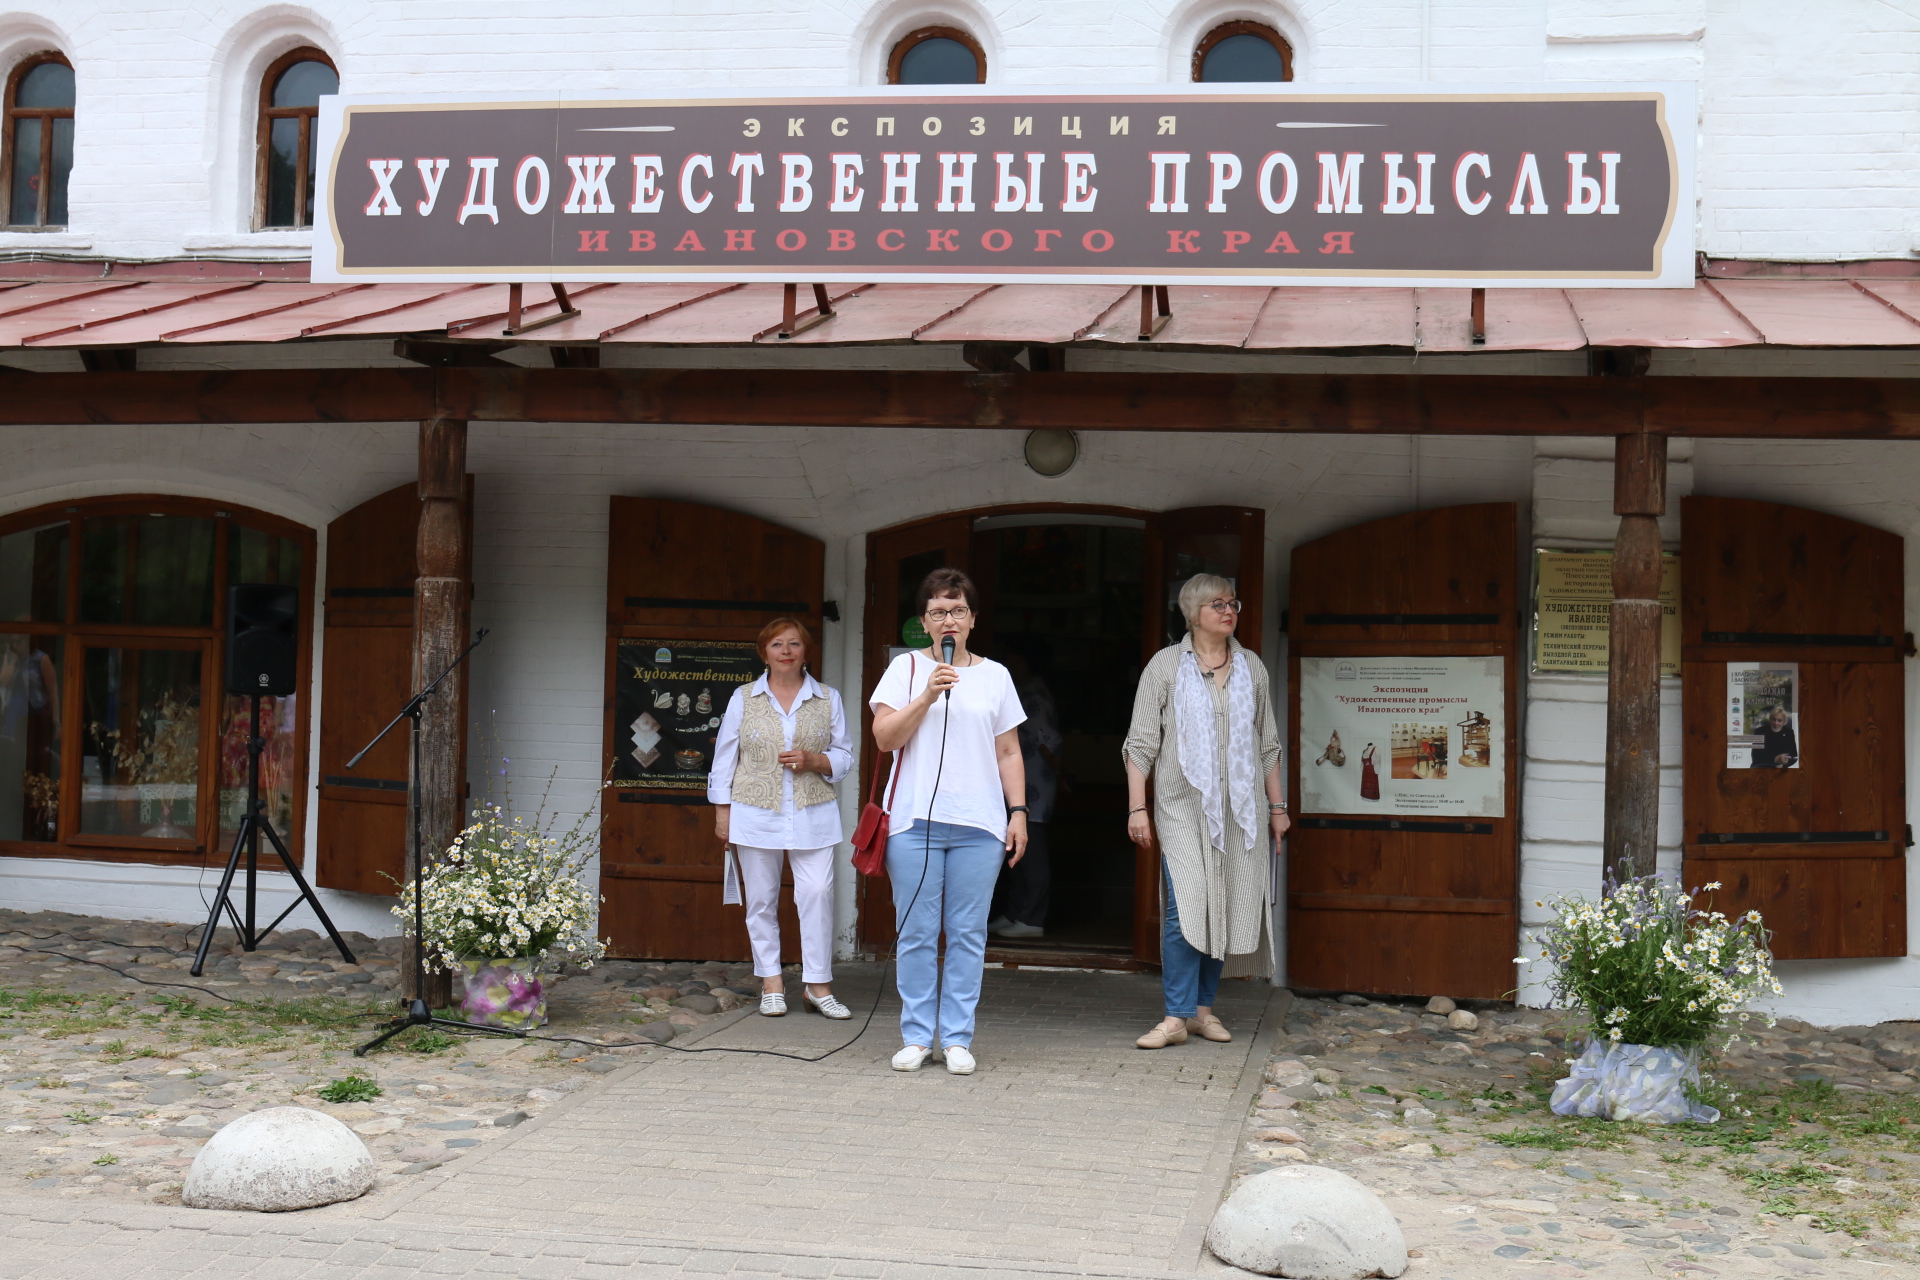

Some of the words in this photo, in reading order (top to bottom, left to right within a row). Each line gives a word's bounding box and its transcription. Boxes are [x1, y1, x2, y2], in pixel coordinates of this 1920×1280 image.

[741, 114, 1178, 140] ЭКСПОЗИЦИЯ
[363, 152, 1099, 226] ХУДОЖЕСТВЕННЫЕ
[1146, 151, 1621, 216] ПРОМЫСЛЫ
[577, 228, 1116, 254] ИВАНОВСКОГО
[1165, 229, 1356, 255] КРАЯ
[632, 667, 753, 682] Художественный
[1373, 685, 1428, 694] Экспозиция
[1419, 697, 1468, 706] промыслы
[1357, 705, 1418, 714] Ивановского
